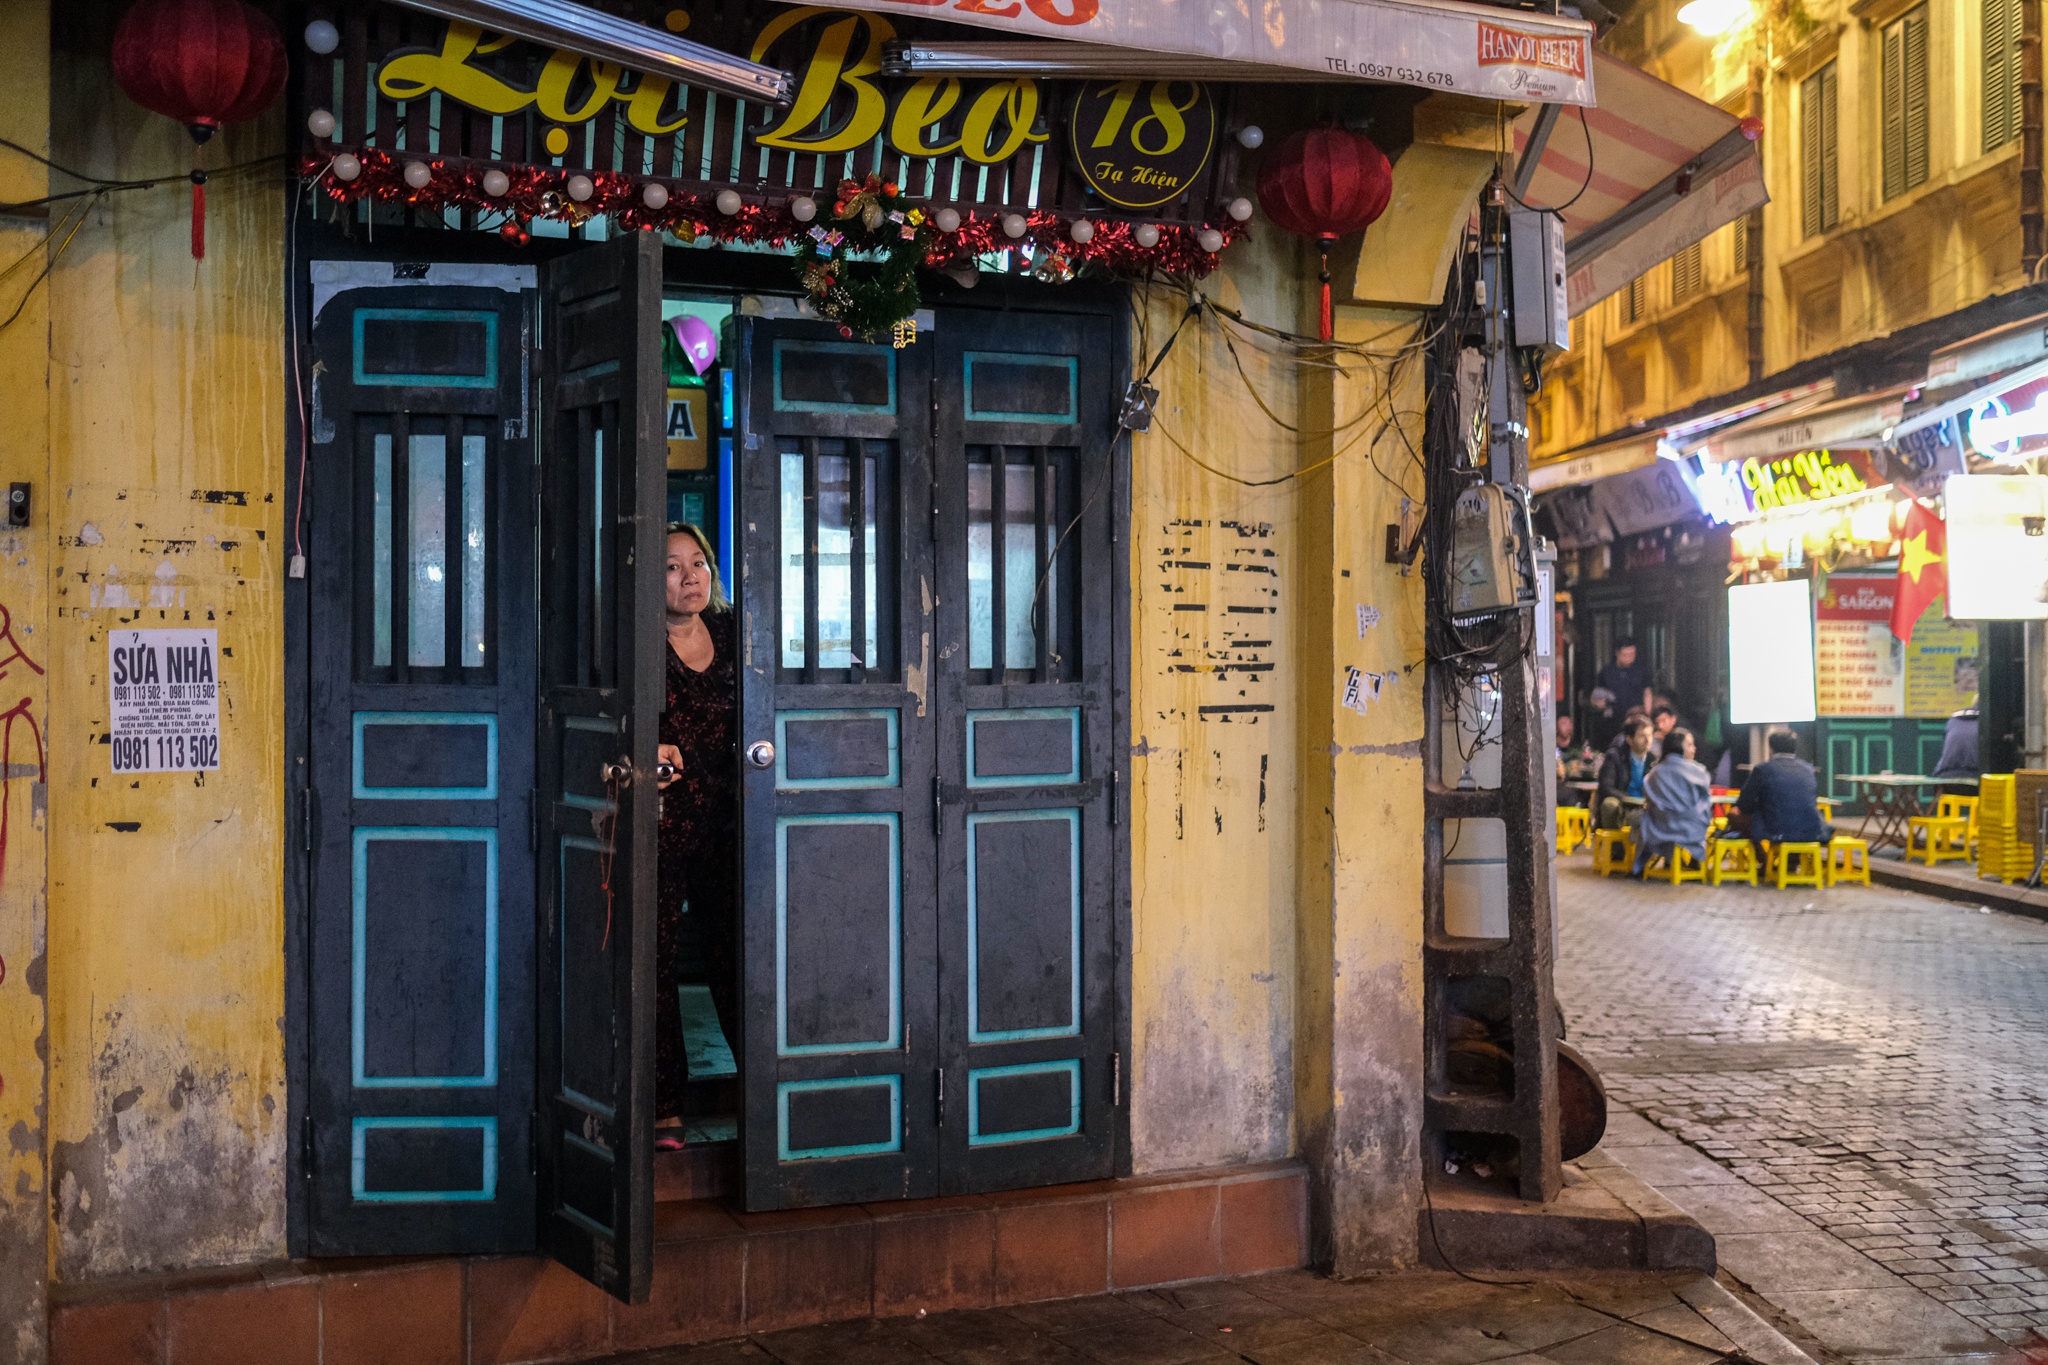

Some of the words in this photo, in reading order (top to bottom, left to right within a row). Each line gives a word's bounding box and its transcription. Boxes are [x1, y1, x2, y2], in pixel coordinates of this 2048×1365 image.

[1481, 25, 1537, 62] HANOI
[1539, 38, 1581, 73] BEER
[1325, 56, 1356, 74] TEL:
[1359, 62, 1392, 78] 0987
[1397, 67, 1423, 83] 932
[1428, 72, 1454, 87] 678
[1509, 68, 1557, 92] Premium
[1091, 80, 1201, 157] 18
[1095, 160, 1123, 184] Tạ
[1131, 165, 1180, 190] Hiện
[113, 632, 159, 685] SỬA
[166, 638, 214, 684] NHÀ
[114, 686, 131, 700] 0981
[134, 686, 146, 700] 113
[148, 685, 161, 700] 502
[169, 685, 186, 699] 0981
[188, 685, 201, 699] 113
[202, 684, 215, 699] 502
[113, 736, 149, 770] 0981
[157, 735, 185, 768] 113
[190, 735, 218, 767] 502
